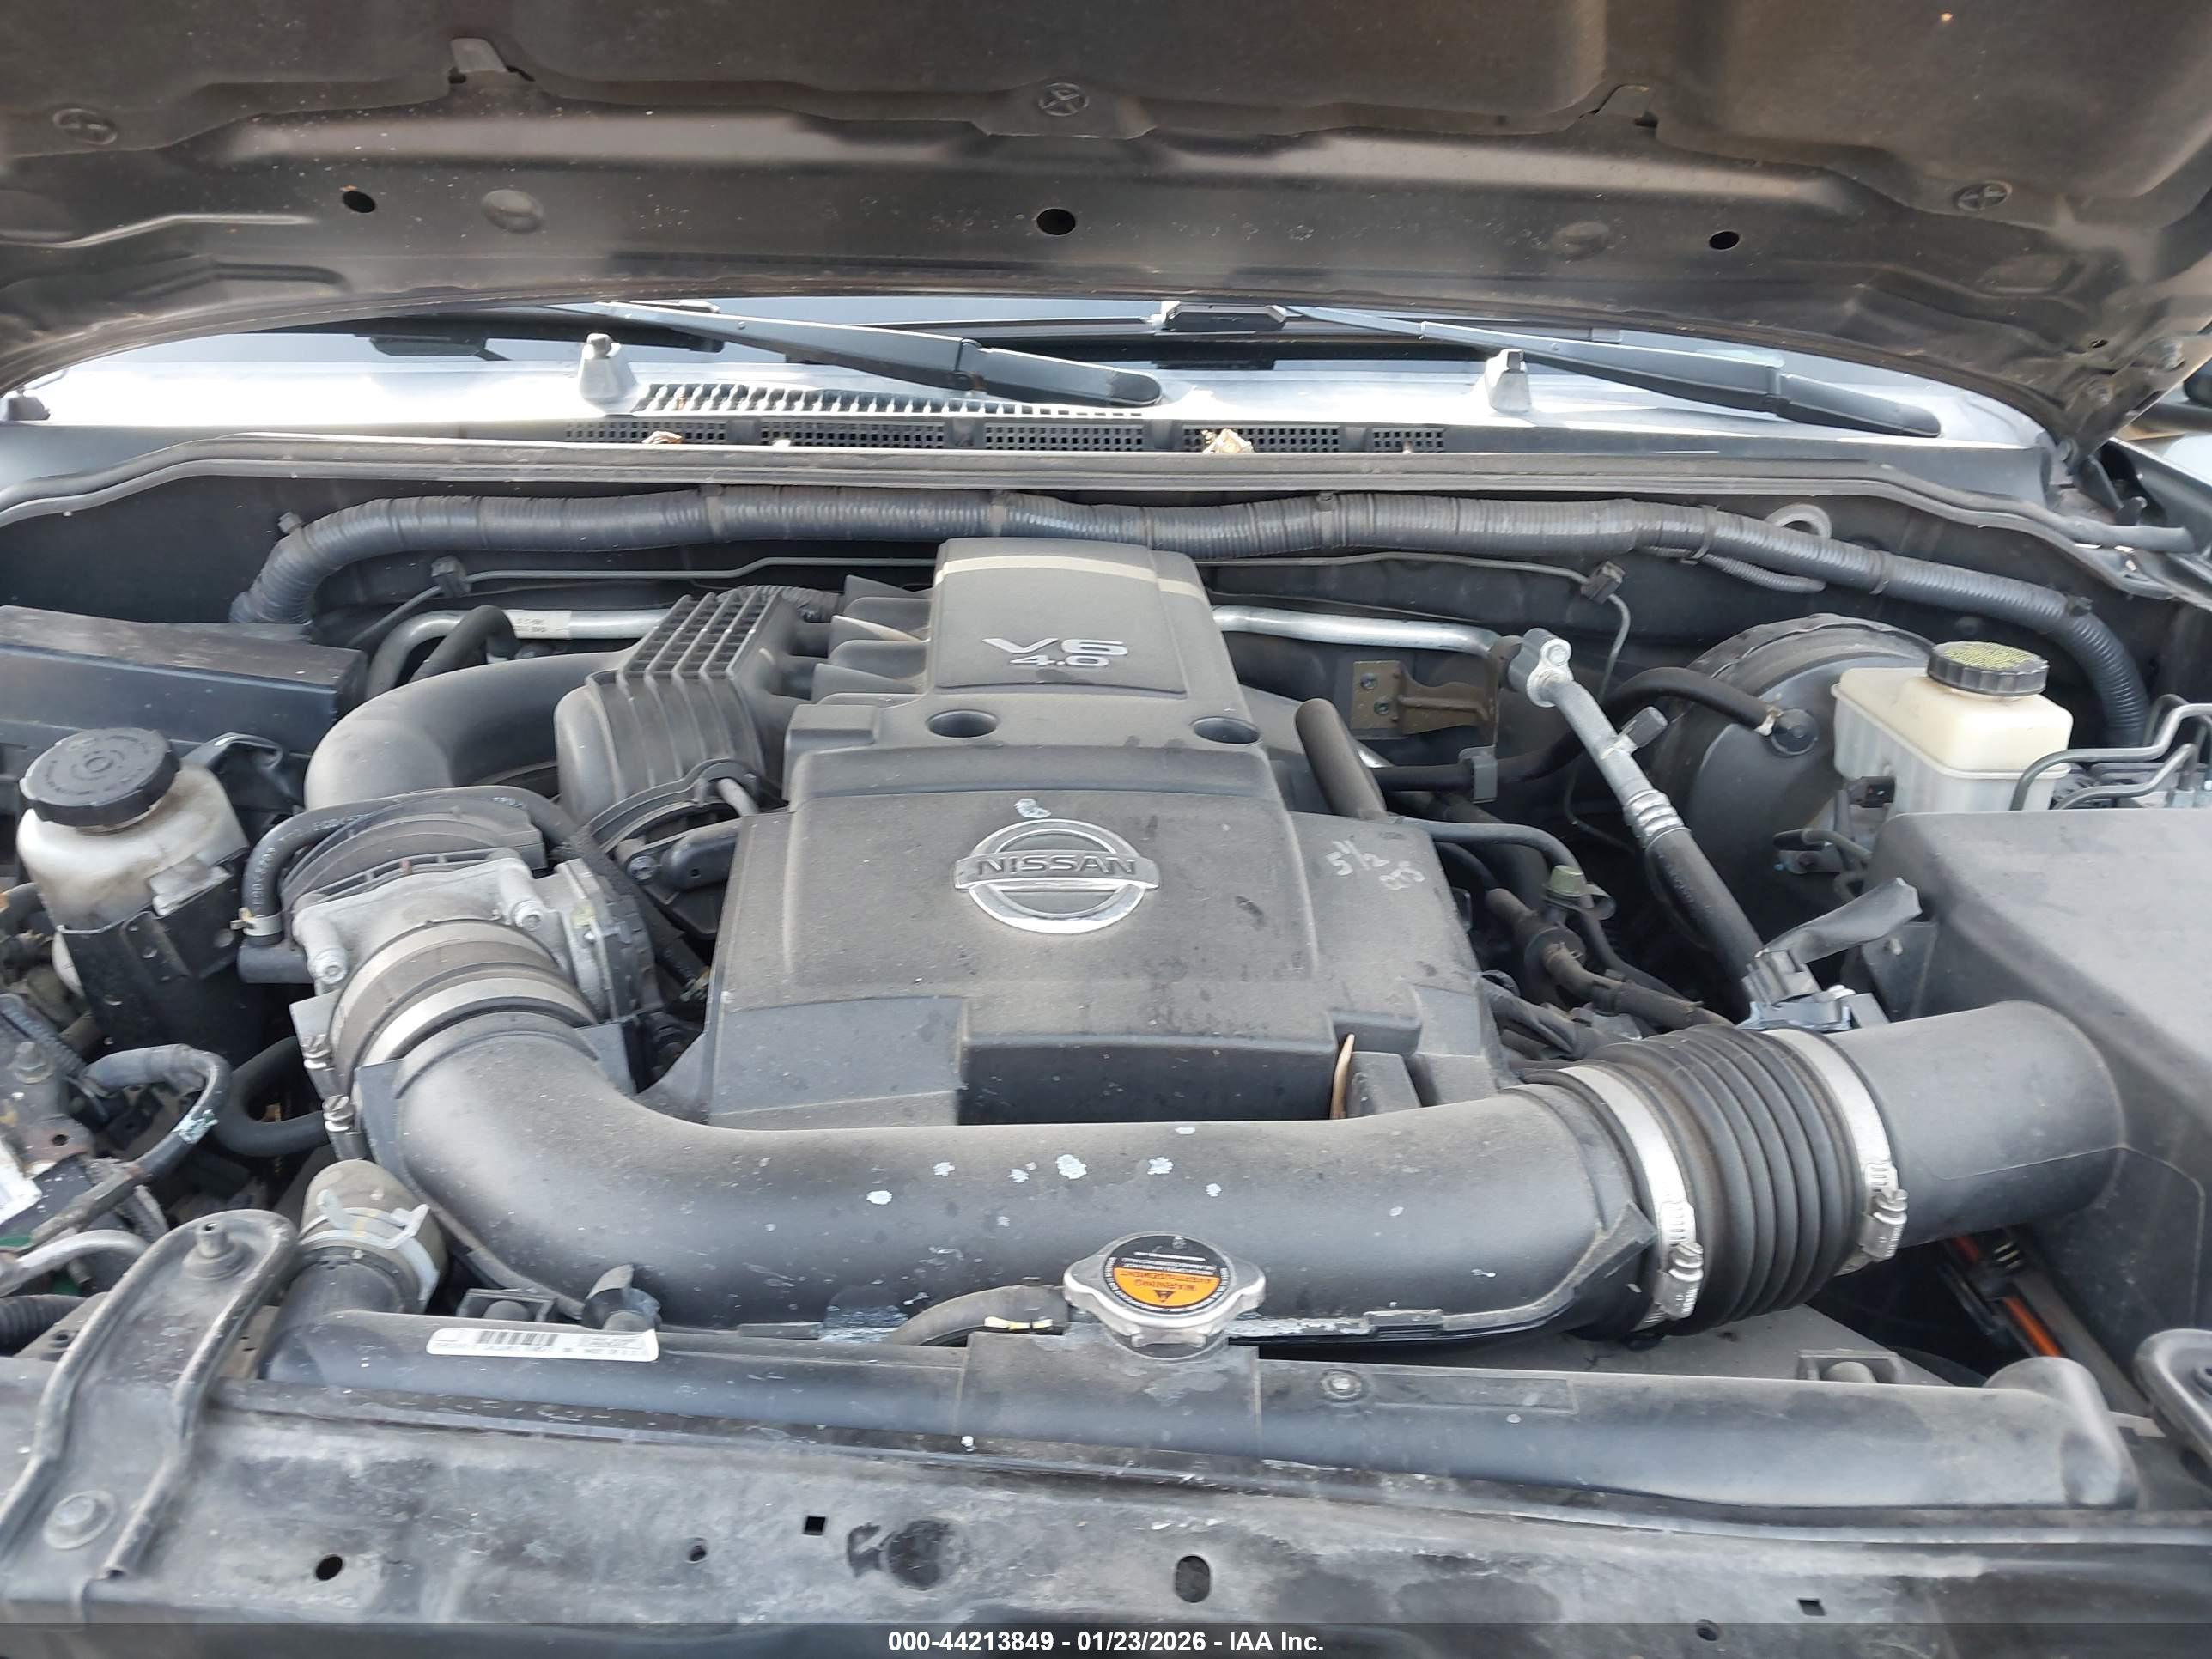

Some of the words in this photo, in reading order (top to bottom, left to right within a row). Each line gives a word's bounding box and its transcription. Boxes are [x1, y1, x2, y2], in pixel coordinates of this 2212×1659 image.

[981, 637, 1128, 656] V6
[1009, 654, 1109, 667] 4.0
[977, 854, 1137, 876] NISSAN
